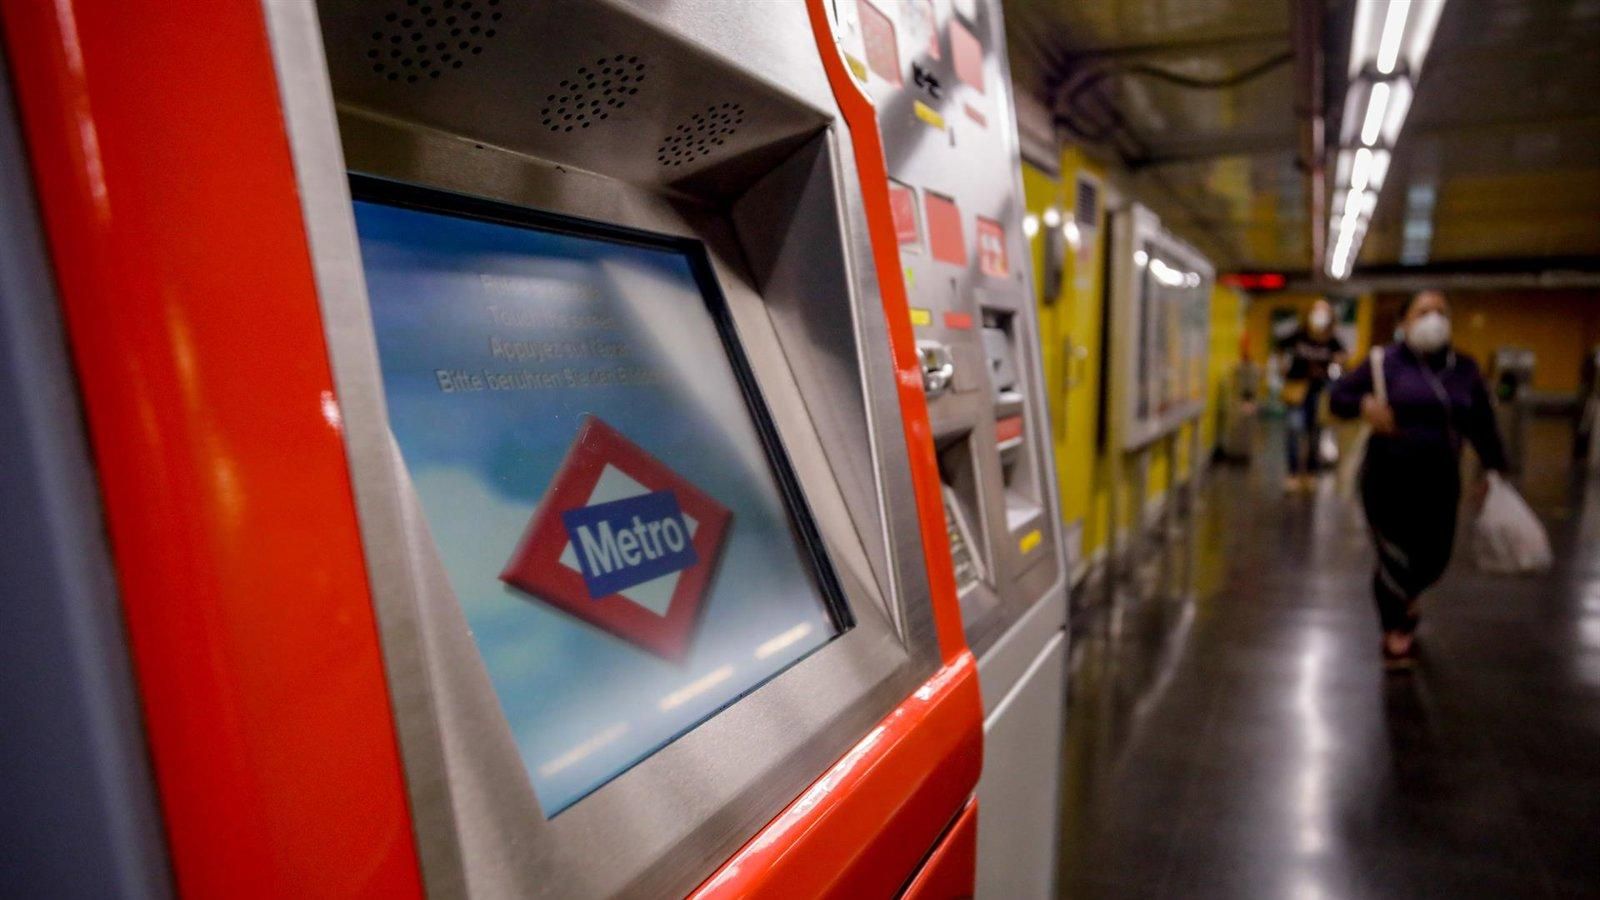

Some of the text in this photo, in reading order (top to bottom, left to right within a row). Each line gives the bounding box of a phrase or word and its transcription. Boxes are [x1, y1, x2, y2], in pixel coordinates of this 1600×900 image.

[489, 336, 563, 363] Appuyez
[435, 368, 483, 394] Bitte
[577, 515, 684, 577] Metro
